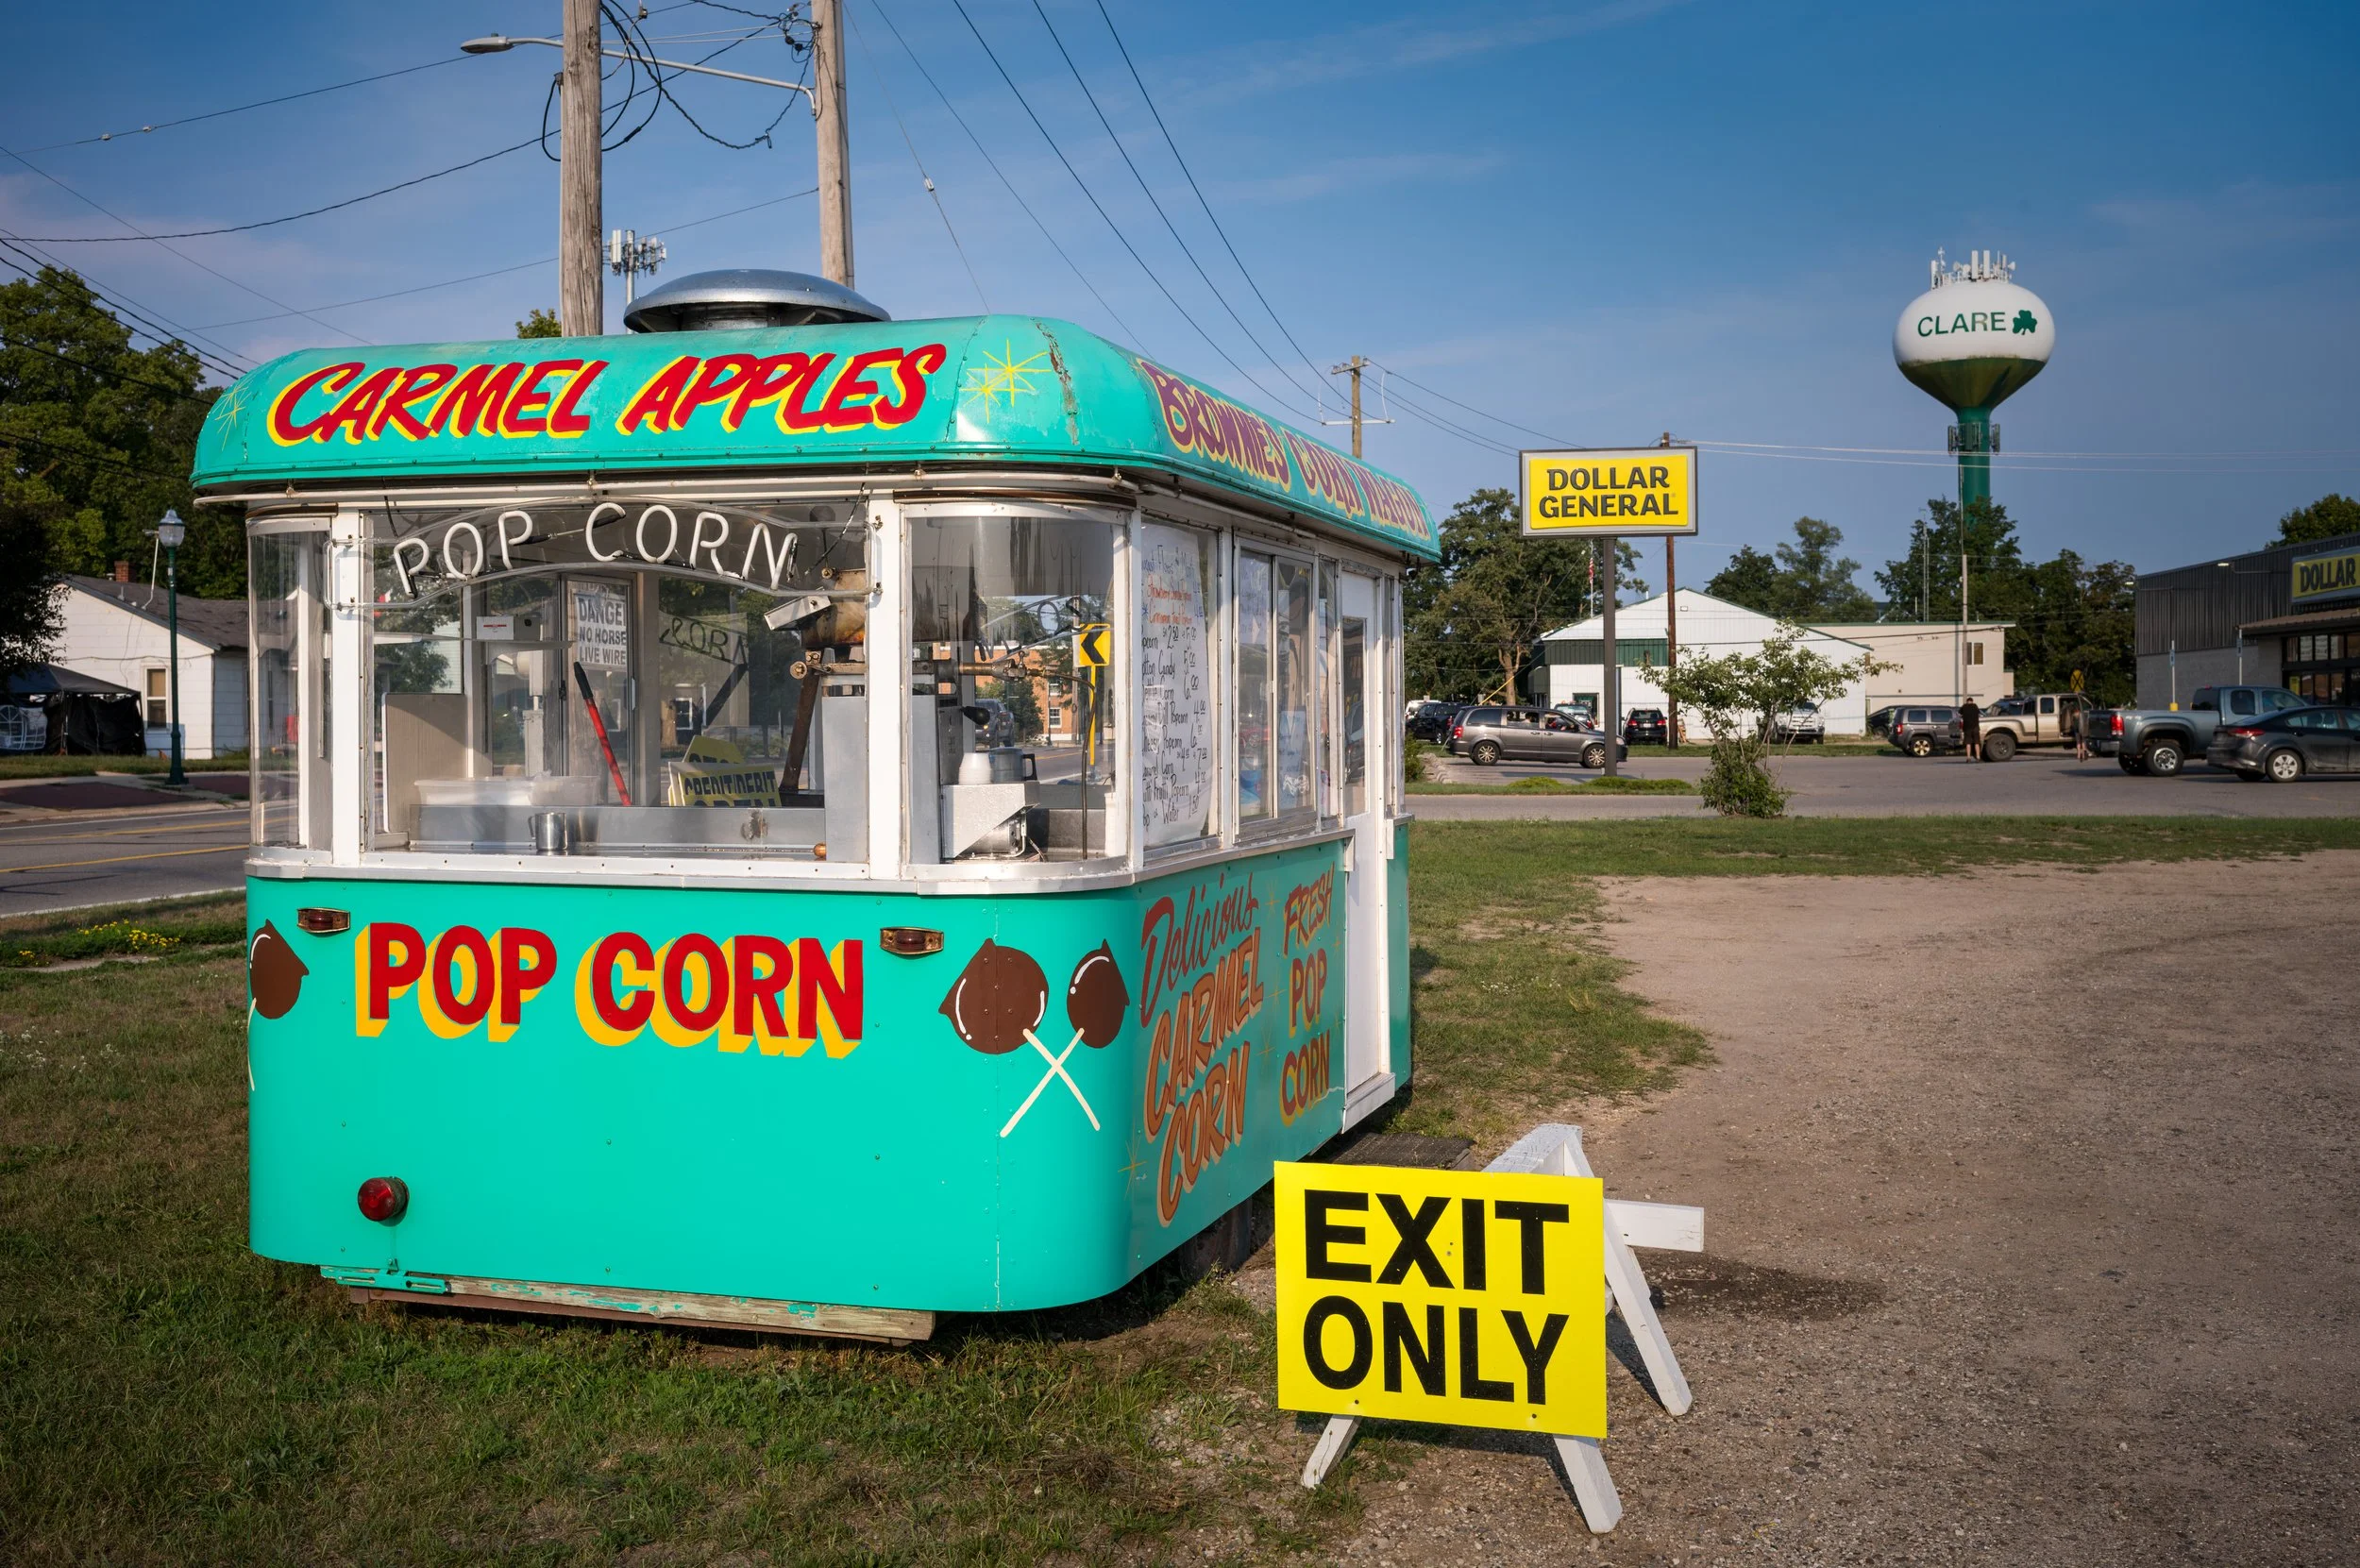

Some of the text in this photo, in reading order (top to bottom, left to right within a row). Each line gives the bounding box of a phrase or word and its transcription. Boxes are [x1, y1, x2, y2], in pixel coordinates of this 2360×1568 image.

[1917, 312, 2006, 337] CLARE
[267, 343, 947, 447] CARMEL APPLES
[1136, 357, 1431, 541] BROWNIES CORN WAGON
[1546, 466, 1670, 490] DOLLAR
[1539, 493, 1678, 518] GENERAL
[394, 502, 800, 599] POP CORN
[2300, 558, 2356, 593] DOLLAR
[578, 597, 626, 626] DANGE
[580, 627, 627, 646] NO HORSE
[580, 647, 626, 665] LIVE WIRE
[1158, 649, 1175, 680] Candy
[1162, 725, 1182, 755] Popcorn
[1170, 700, 1188, 726] Popcorn
[1162, 798, 1179, 824] Water
[1170, 773, 1189, 802] Popcorn
[1283, 861, 1335, 957] FRESH
[1140, 871, 1258, 1028] Delicious
[355, 922, 864, 1059] POP CORN
[1289, 949, 1327, 1038] POP
[1144, 927, 1264, 1143] CARMEL
[1279, 1032, 1330, 1126] CORN
[1156, 1040, 1250, 1227] CORN
[1305, 1189, 1570, 1295] EXIT
[1303, 1295, 1570, 1405] ONLY
